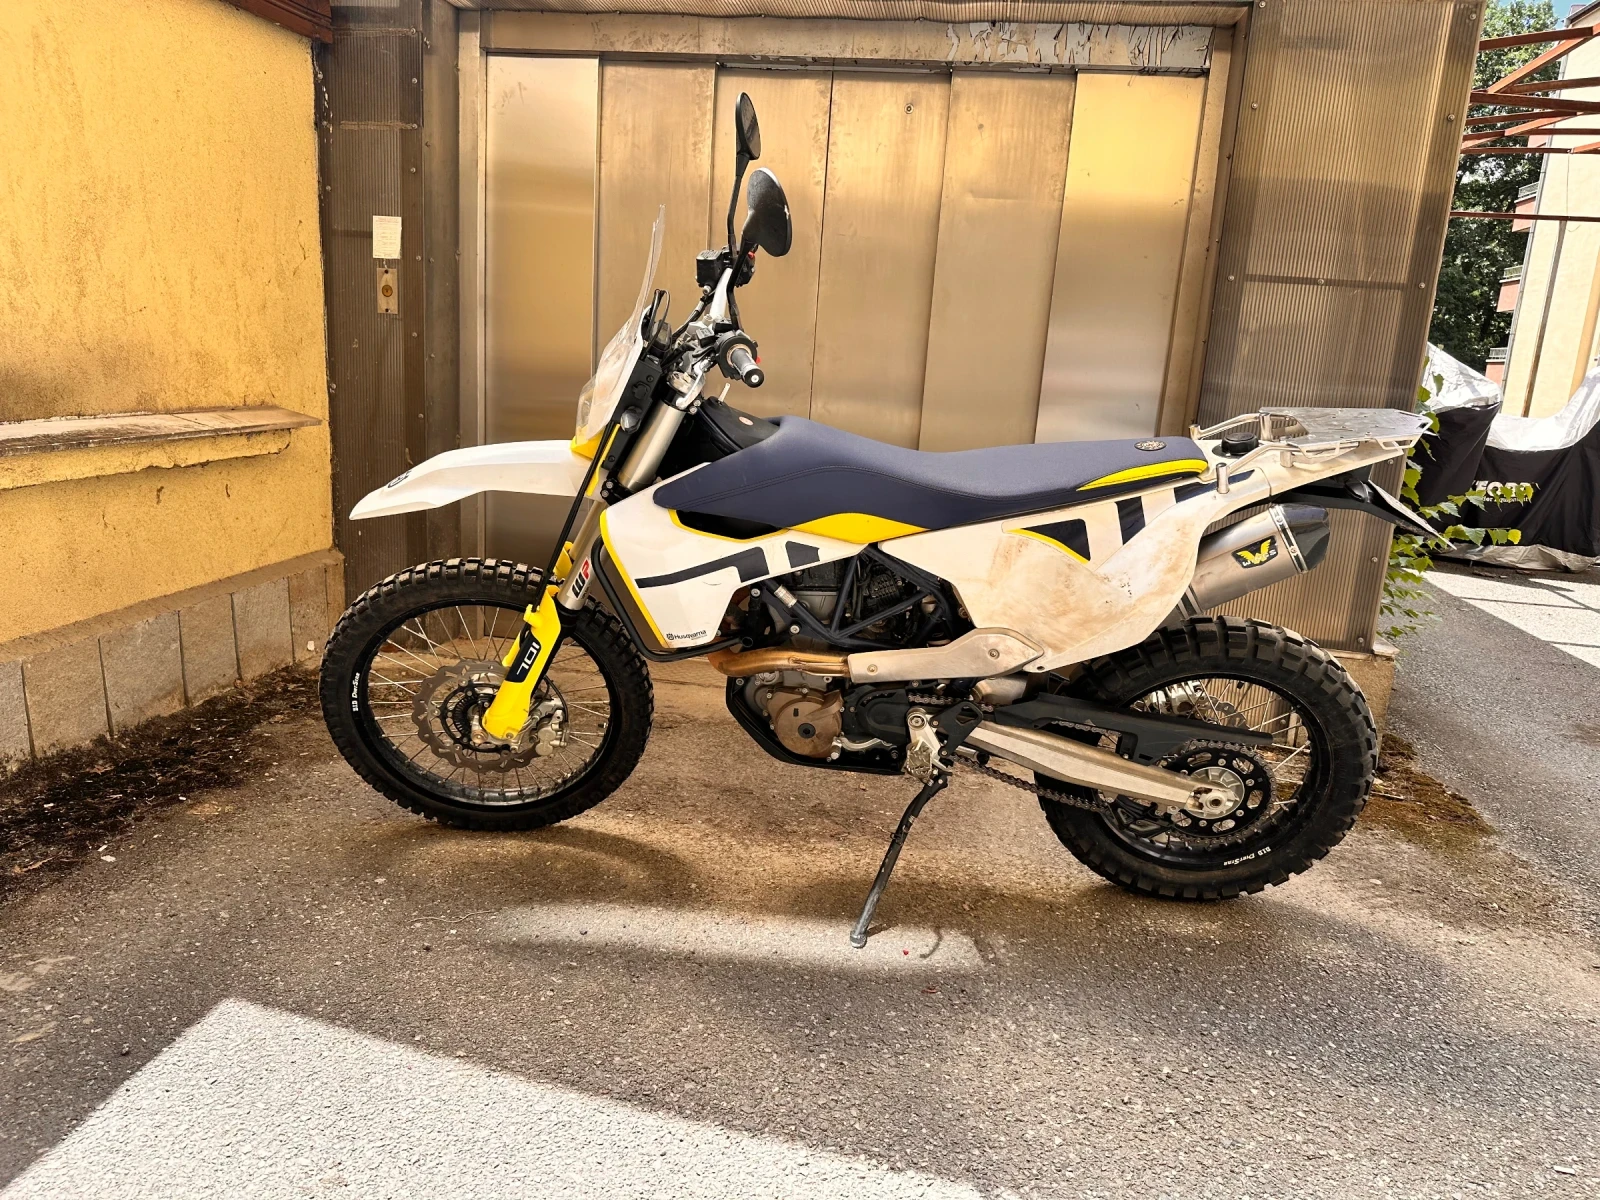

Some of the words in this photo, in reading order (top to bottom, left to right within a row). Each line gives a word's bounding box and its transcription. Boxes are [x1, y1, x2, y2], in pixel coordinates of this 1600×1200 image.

[571, 559, 591, 599] WP
[674, 630, 707, 640] Husqvarna
[516, 641, 540, 676] 701
